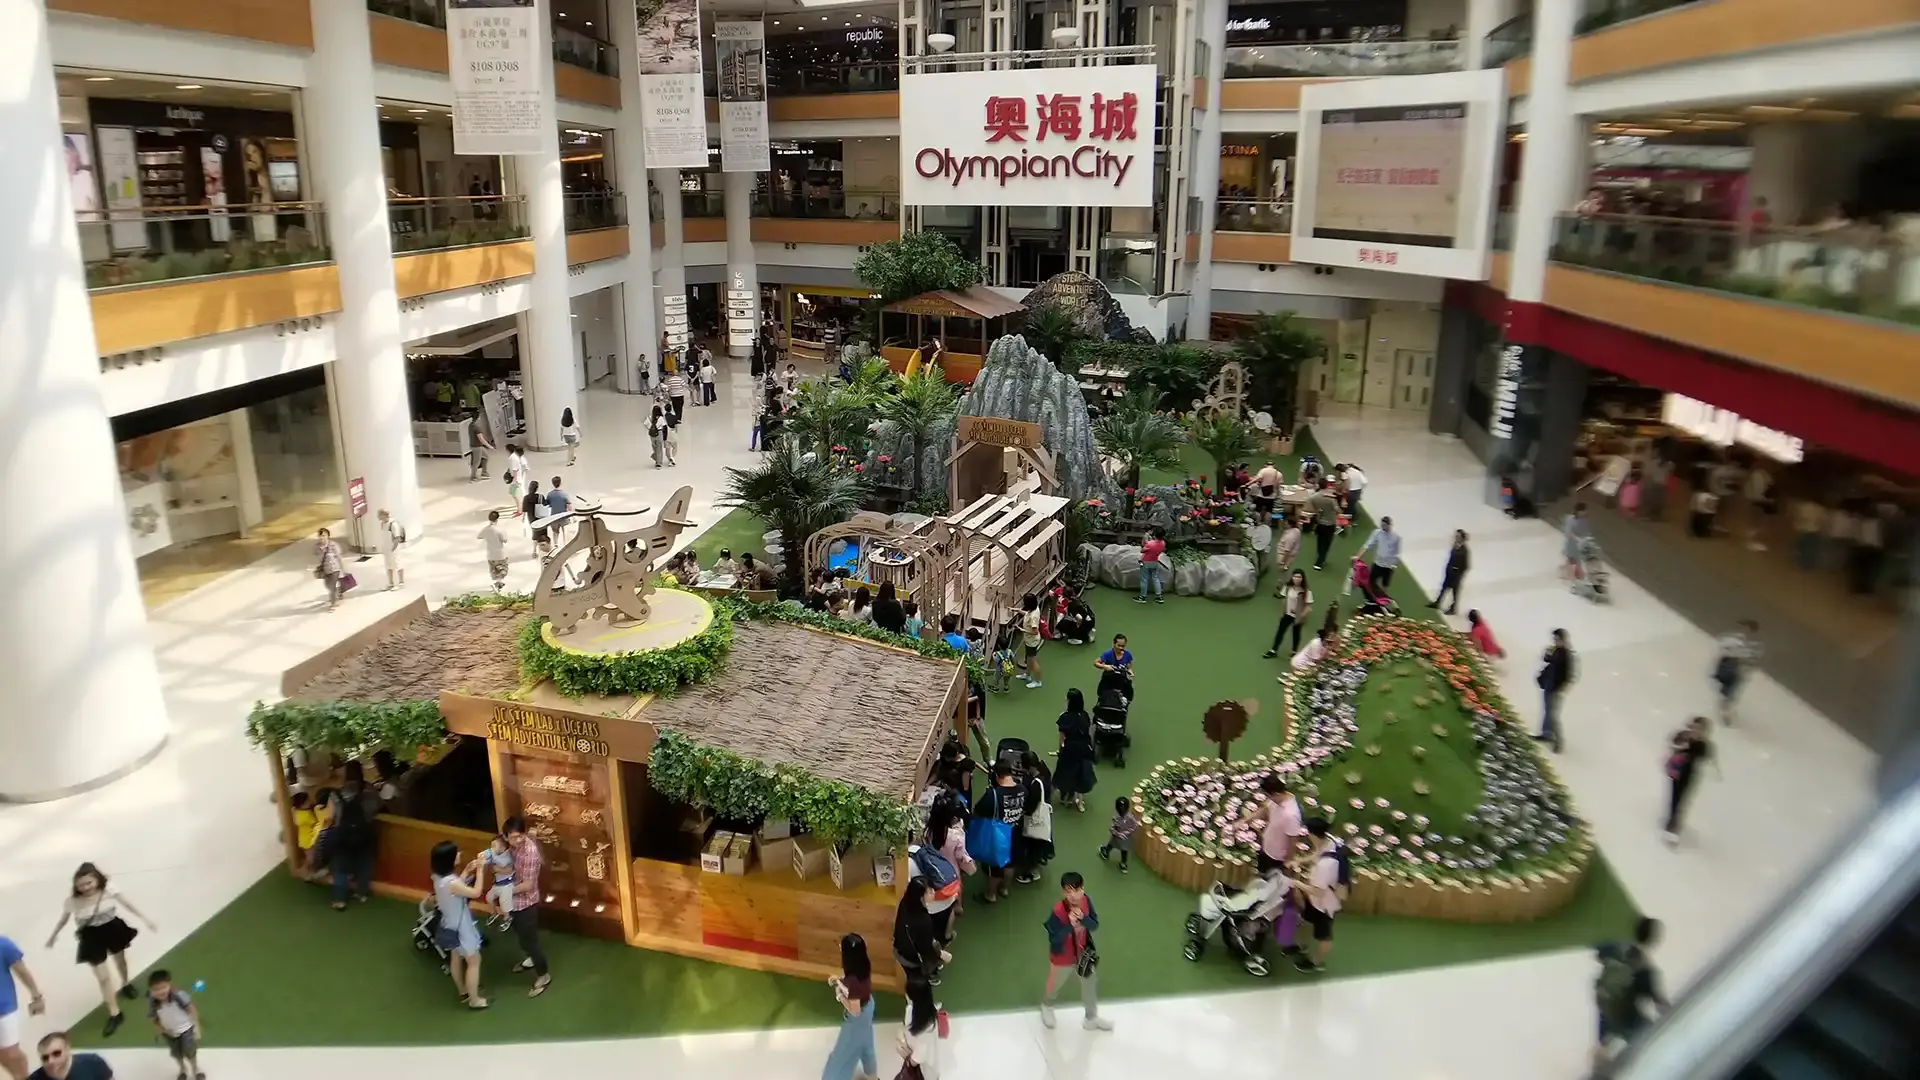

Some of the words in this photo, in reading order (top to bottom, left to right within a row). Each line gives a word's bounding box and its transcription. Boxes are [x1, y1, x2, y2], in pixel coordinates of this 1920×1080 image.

[846, 28, 884, 43] republic
[470, 61, 493, 72] 8108
[495, 61, 520, 72] 0308
[1061, 273, 1083, 283] STEM
[1053, 283, 1094, 295] ADVENTURE
[1060, 295, 1087, 308] WORLD
[688, 365, 695, 373] 3
[1489, 379, 1519, 440] MUJI
[494, 706, 508, 724] OC
[509, 706, 535, 729] STEM
[536, 713, 554, 731] LAB
[562, 717, 599, 738] UGEARS
[486, 721, 512, 741] STEM
[514, 727, 568, 751] ADVENTURE
